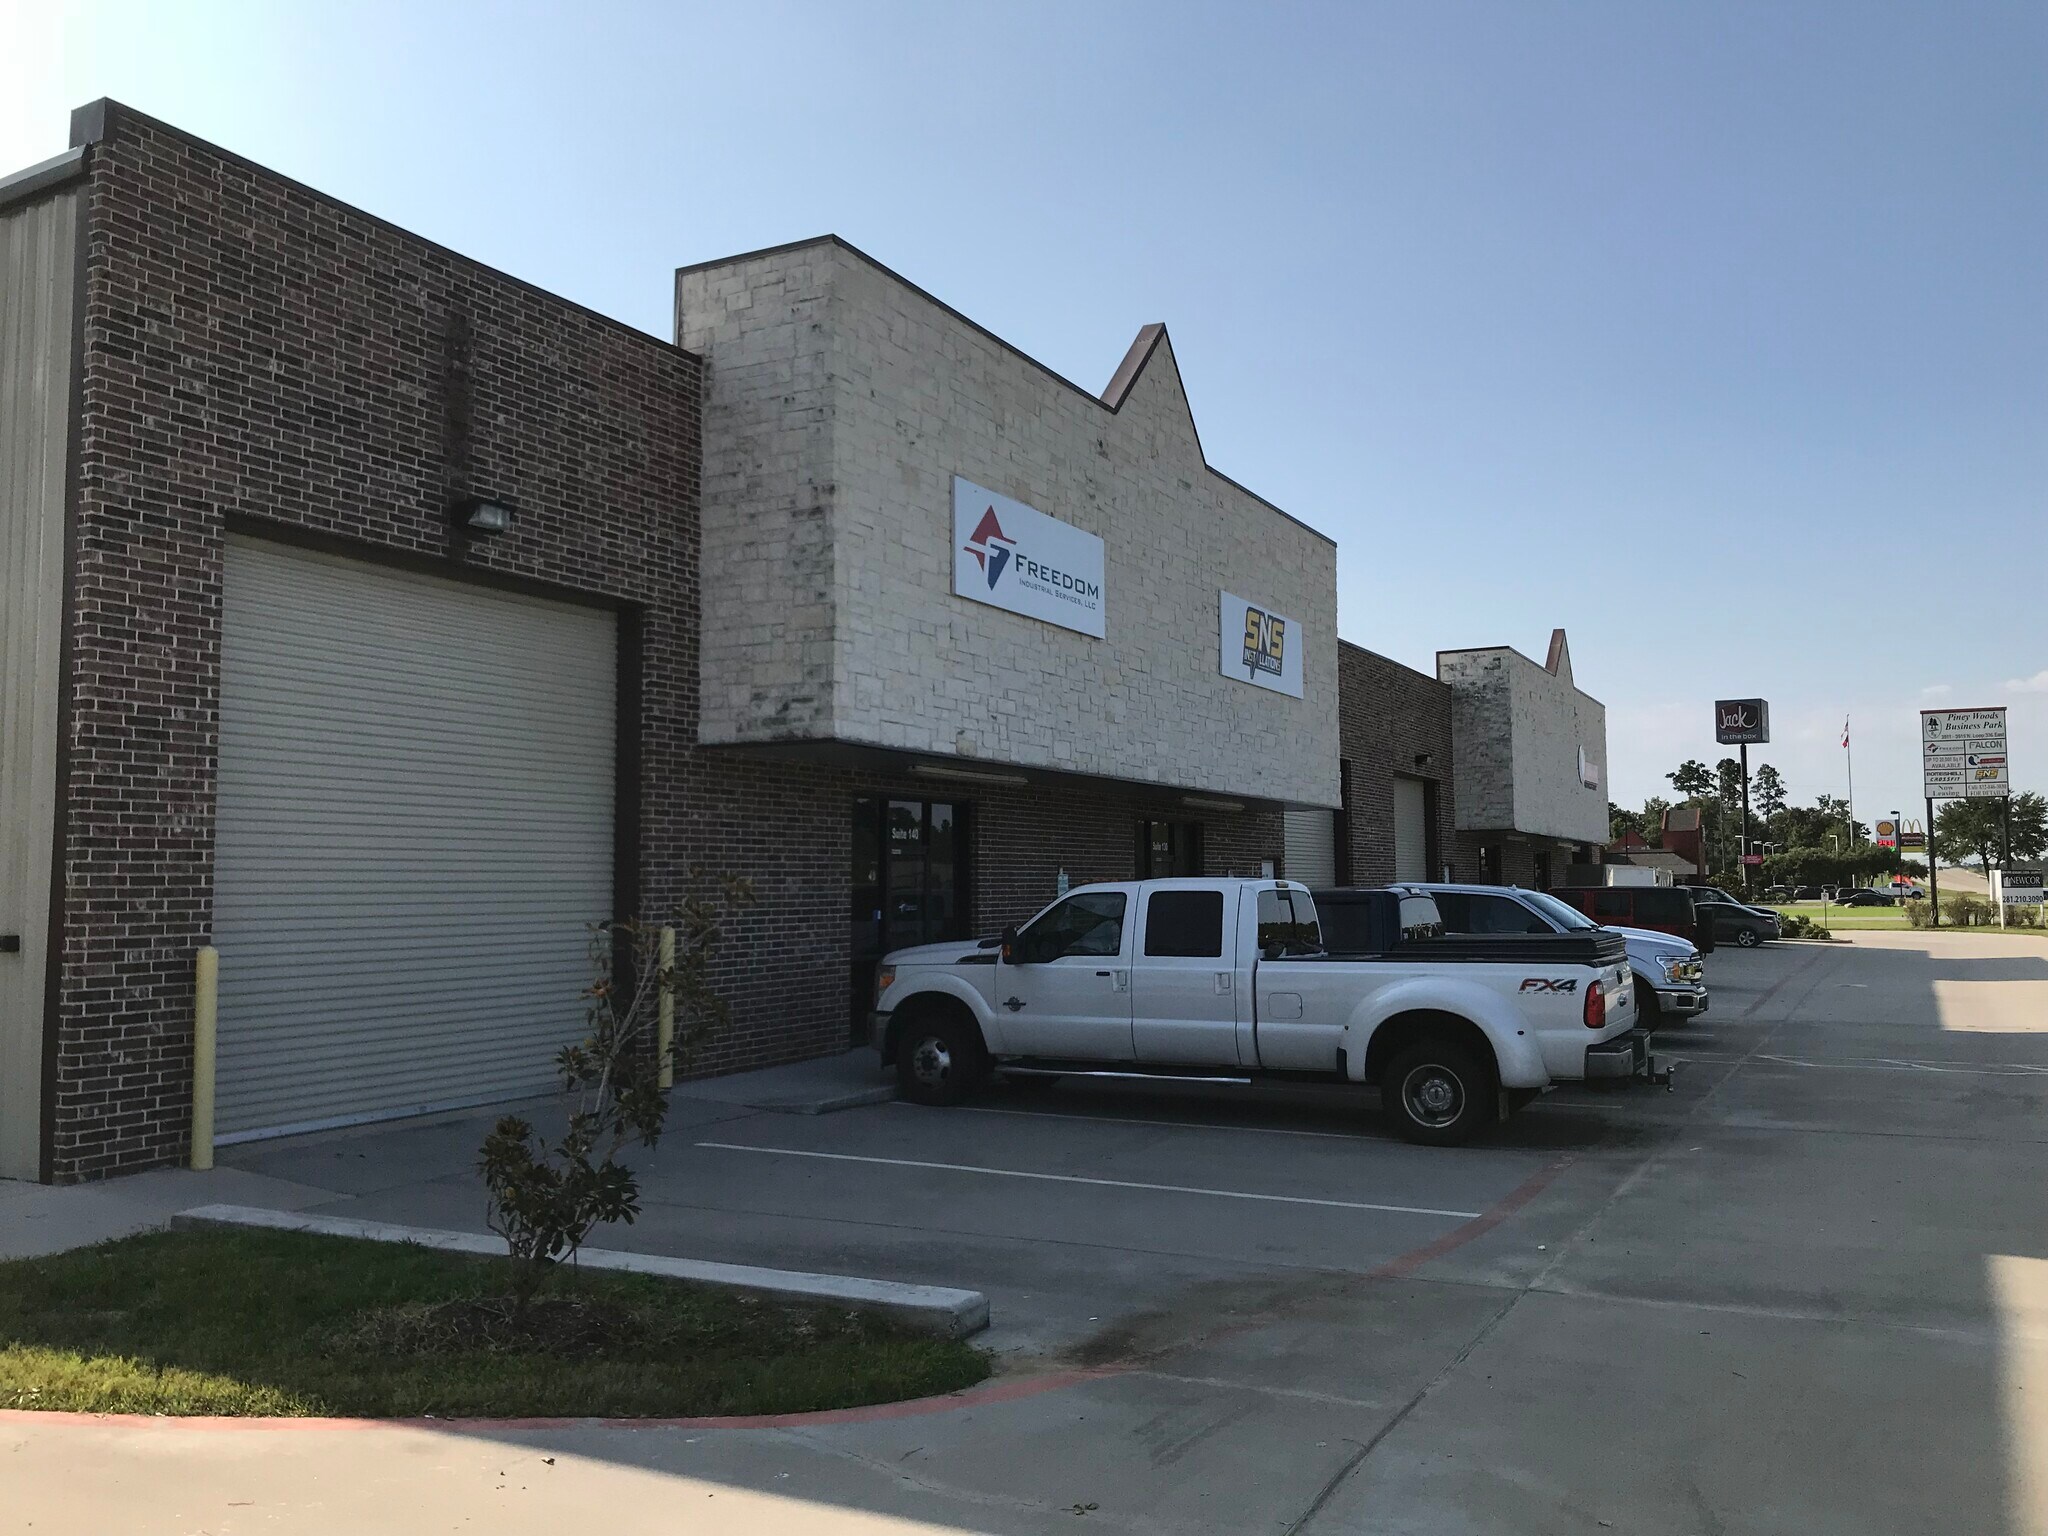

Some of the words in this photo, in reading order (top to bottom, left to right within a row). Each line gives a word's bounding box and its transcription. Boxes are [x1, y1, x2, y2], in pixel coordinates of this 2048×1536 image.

[1015, 553, 1099, 600] FREEDOM
[1019, 578, 1054, 596] INDUSTRIAL
[1054, 589, 1083, 606] SERVICES,
[1084, 600, 1097, 610] LLC
[1244, 606, 1285, 659] SNS
[1720, 705, 1757, 729] Jack
[1947, 713, 1971, 722] Piney
[1972, 712, 1999, 720] Woods
[1945, 722, 1981, 731] Business
[1983, 721, 2003, 729] Park
[1969, 740, 2002, 749] FALCON
[1976, 769, 1998, 777] SNS
[891, 827, 907, 840] Suite
[2010, 876, 2041, 885] NEWCOR
[1519, 978, 1579, 992] FX4
